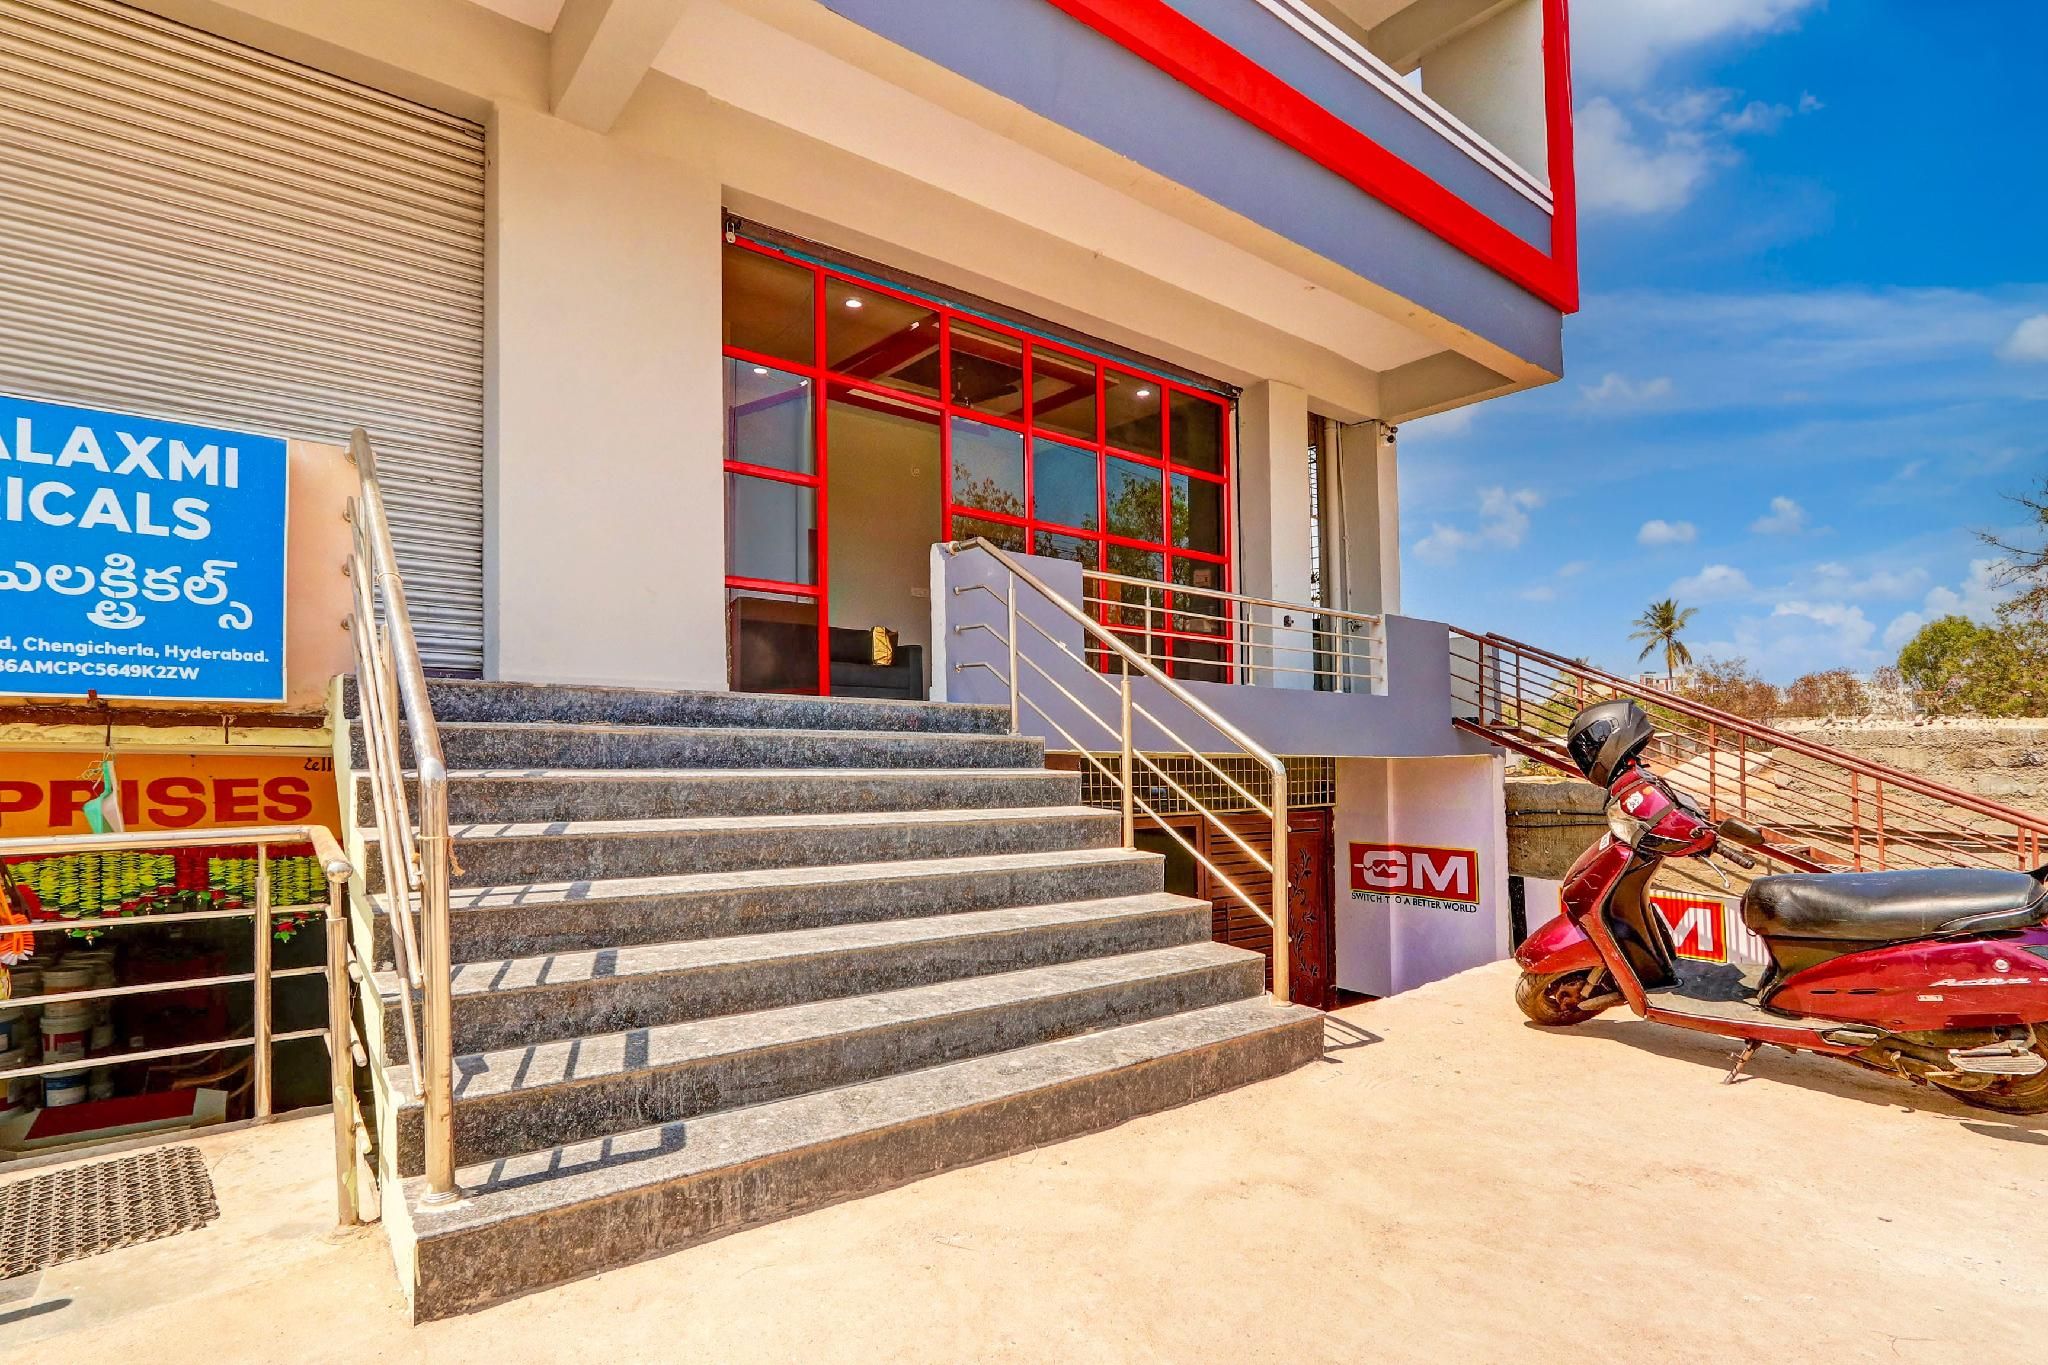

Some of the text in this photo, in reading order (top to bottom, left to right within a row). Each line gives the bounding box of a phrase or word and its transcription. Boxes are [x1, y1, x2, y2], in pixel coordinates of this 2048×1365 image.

[0, 417, 239, 489] LAXMI
[23, 636, 160, 659] Chengicherla,
[164, 644, 269, 663] Hyderabad.
[0, 776, 313, 828] PRISES
[1354, 850, 1469, 894] GM
[1351, 892, 1382, 904] SWITCH
[1403, 898, 1411, 906] A
[1412, 897, 1441, 909] BETTER
[1443, 901, 1477, 913] WORLD
